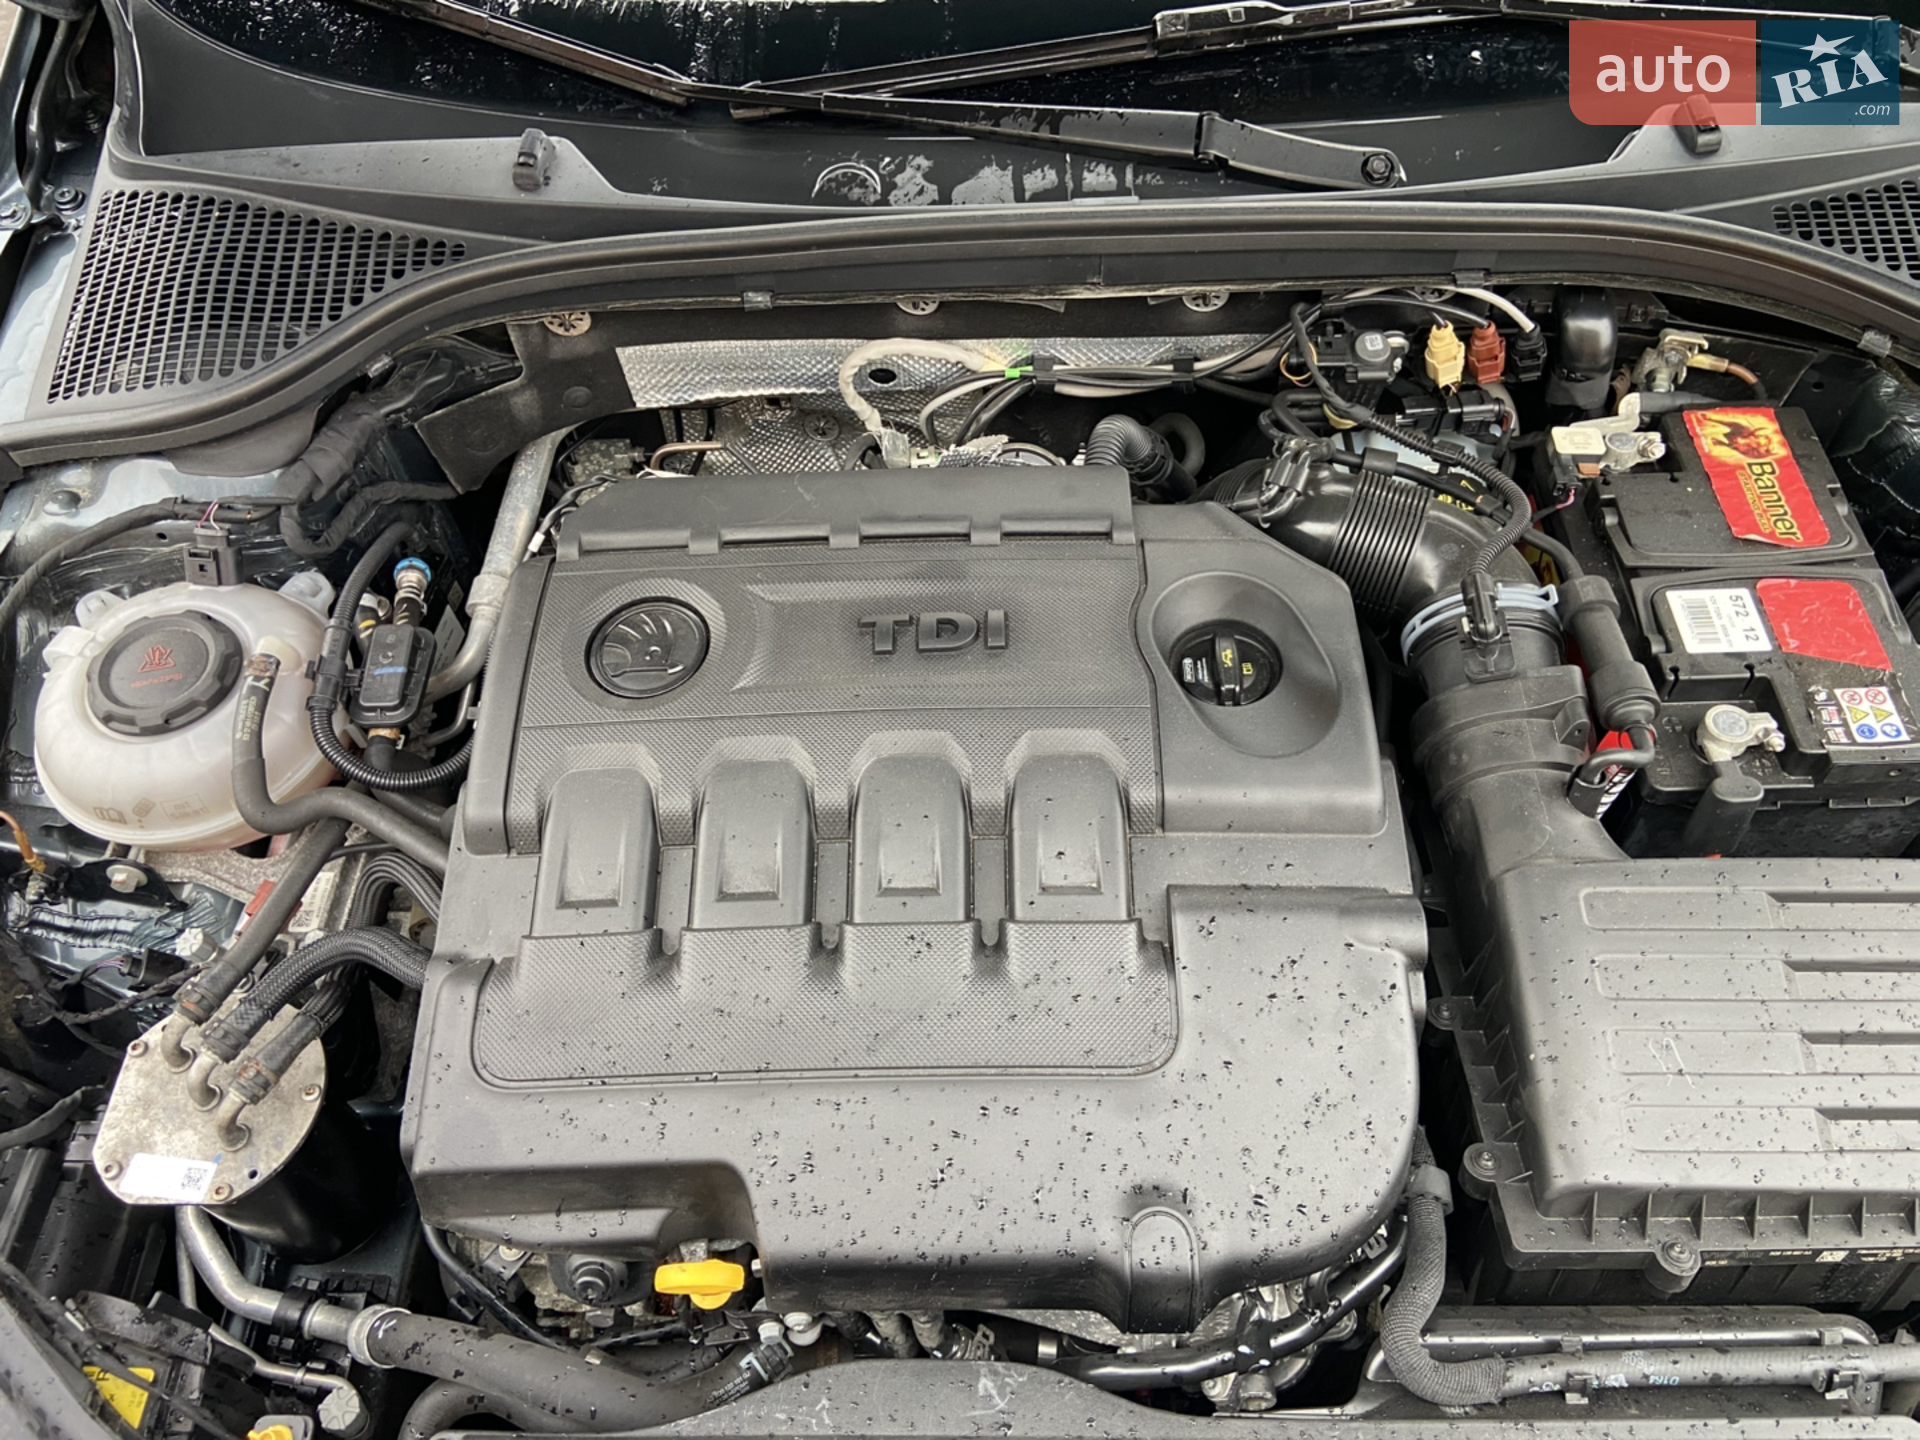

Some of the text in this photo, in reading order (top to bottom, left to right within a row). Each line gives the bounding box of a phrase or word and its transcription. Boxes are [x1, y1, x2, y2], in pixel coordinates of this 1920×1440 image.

[1737, 471, 1770, 533] STARTING BULL
[1746, 461, 1801, 541] Banner
[858, 609, 1008, 655] TDI
[1729, 594, 1750, 618] 572
[1742, 626, 1760, 642] 12
